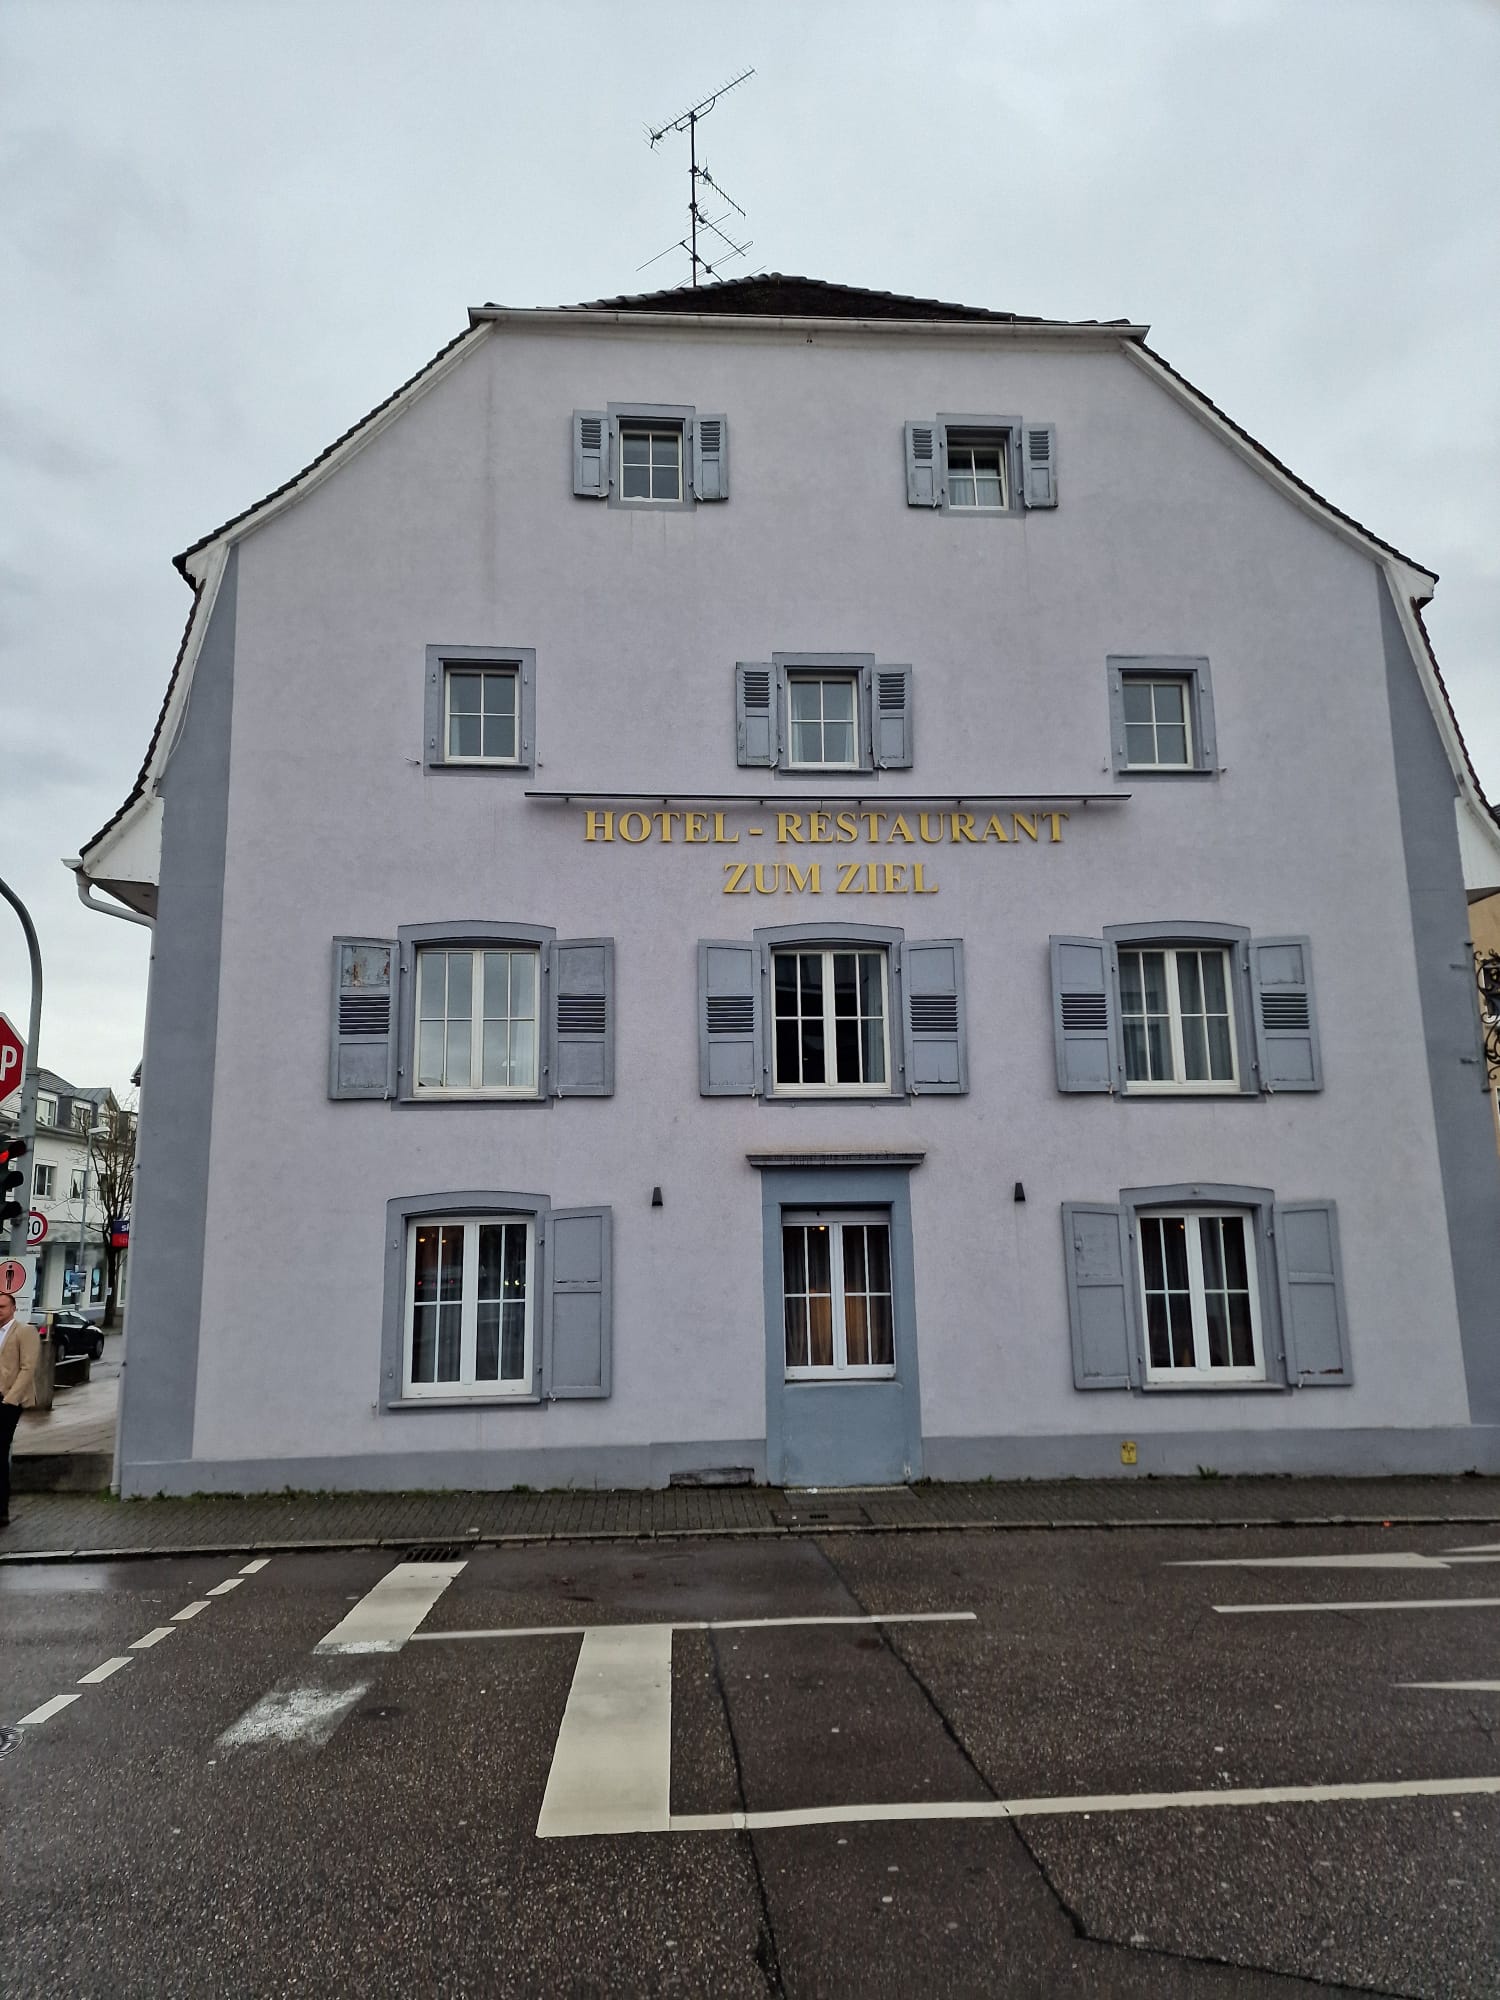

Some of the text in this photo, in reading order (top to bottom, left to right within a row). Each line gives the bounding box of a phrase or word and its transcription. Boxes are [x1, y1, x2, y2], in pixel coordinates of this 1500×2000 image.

[584, 811, 740, 843] HOTEL
[775, 811, 1070, 843] RESTAURANT
[722, 863, 940, 894] ZUM ZIEL
